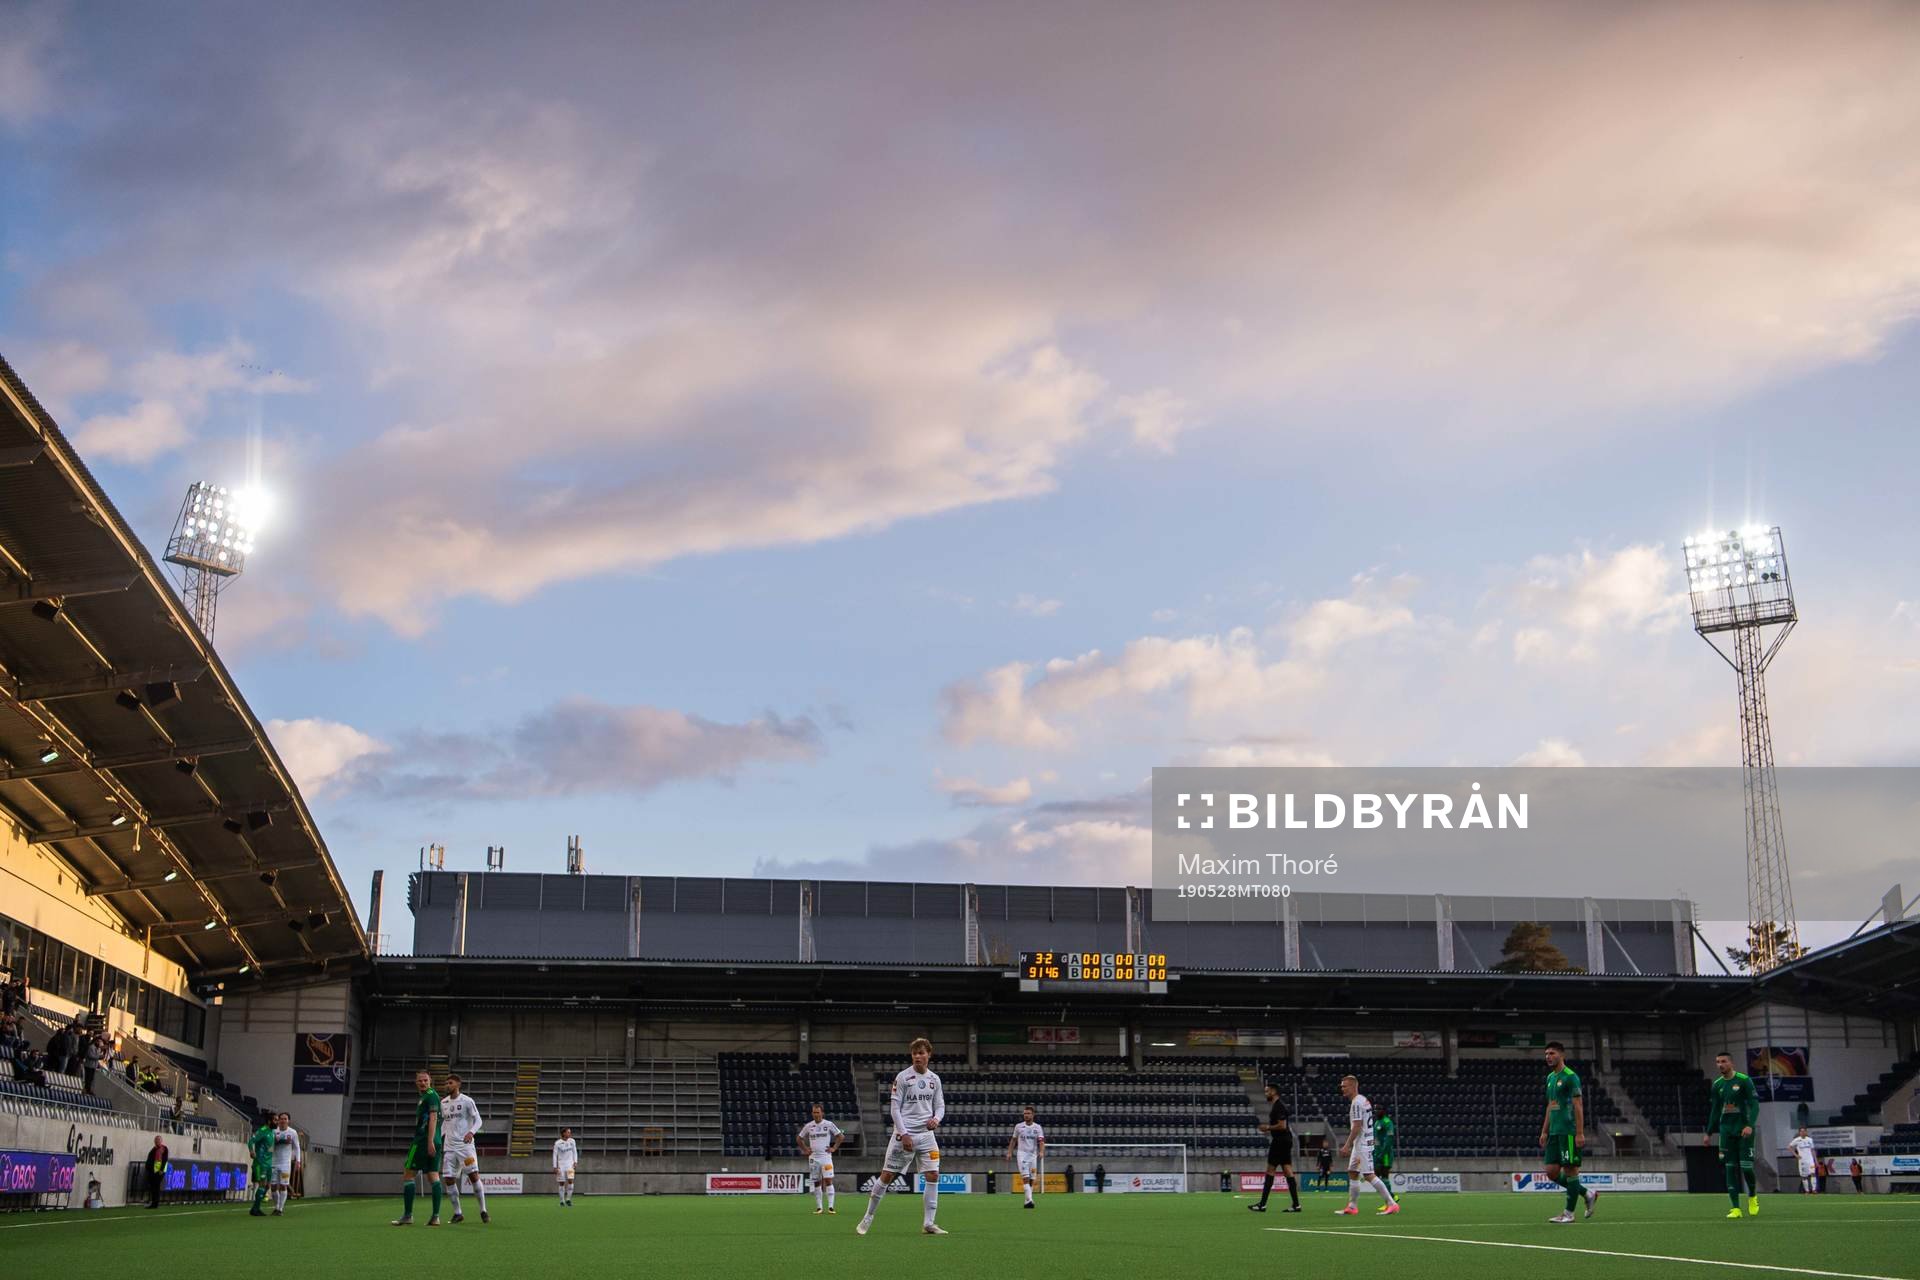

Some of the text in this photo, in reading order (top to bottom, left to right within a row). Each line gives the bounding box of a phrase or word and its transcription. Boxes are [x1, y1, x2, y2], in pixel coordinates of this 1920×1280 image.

[1021, 954, 1028, 962] H
[1070, 955, 1080, 965] A
[1104, 955, 1115, 965] C
[1138, 956, 1145, 965] E
[1071, 968, 1079, 977] B
[1103, 968, 1113, 978] D
[1138, 969, 1144, 978] F
[12, 1165, 37, 1189] OBOS
[768, 1175, 801, 1189] BASTA!
[920, 1175, 965, 1184] SDVIK
[1407, 1174, 1458, 1184] nettbuss
[1616, 1173, 1664, 1185] Engeltofta
[1534, 1182, 1560, 1190] SPORT
